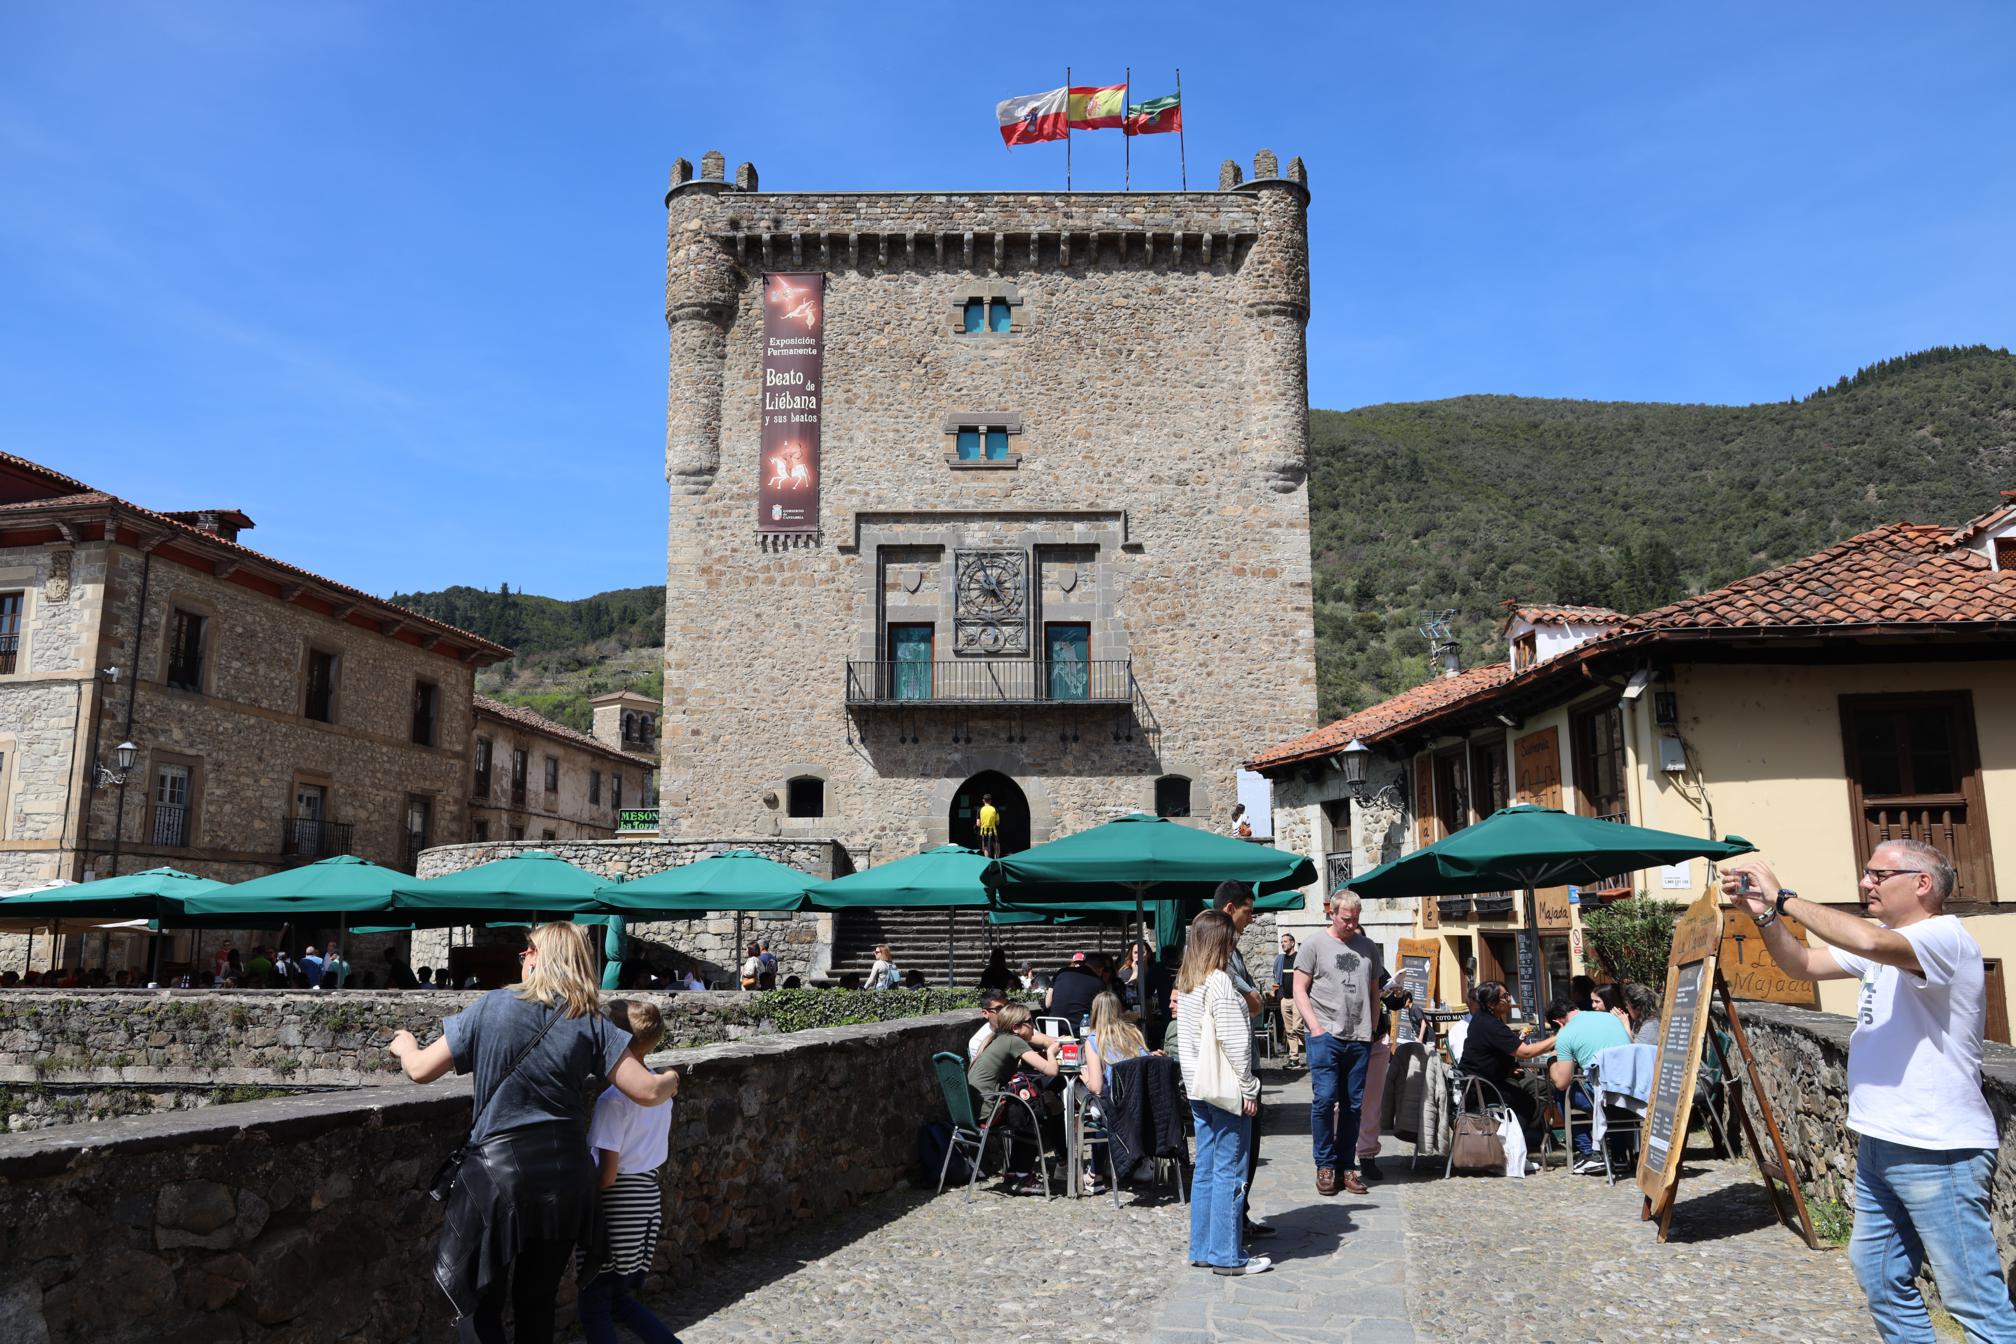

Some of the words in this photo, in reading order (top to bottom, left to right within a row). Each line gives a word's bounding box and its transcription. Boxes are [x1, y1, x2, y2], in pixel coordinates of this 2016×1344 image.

[769, 337, 816, 348] Exposición
[767, 347, 817, 356] Permanente
[766, 368, 804, 387] Beato
[805, 380, 816, 391] de
[765, 391, 817, 410] Liébana
[764, 415, 770, 426] y
[773, 415, 787, 423] sus
[790, 412, 818, 423] beatos
[1539, 901, 1568, 926] Majada
